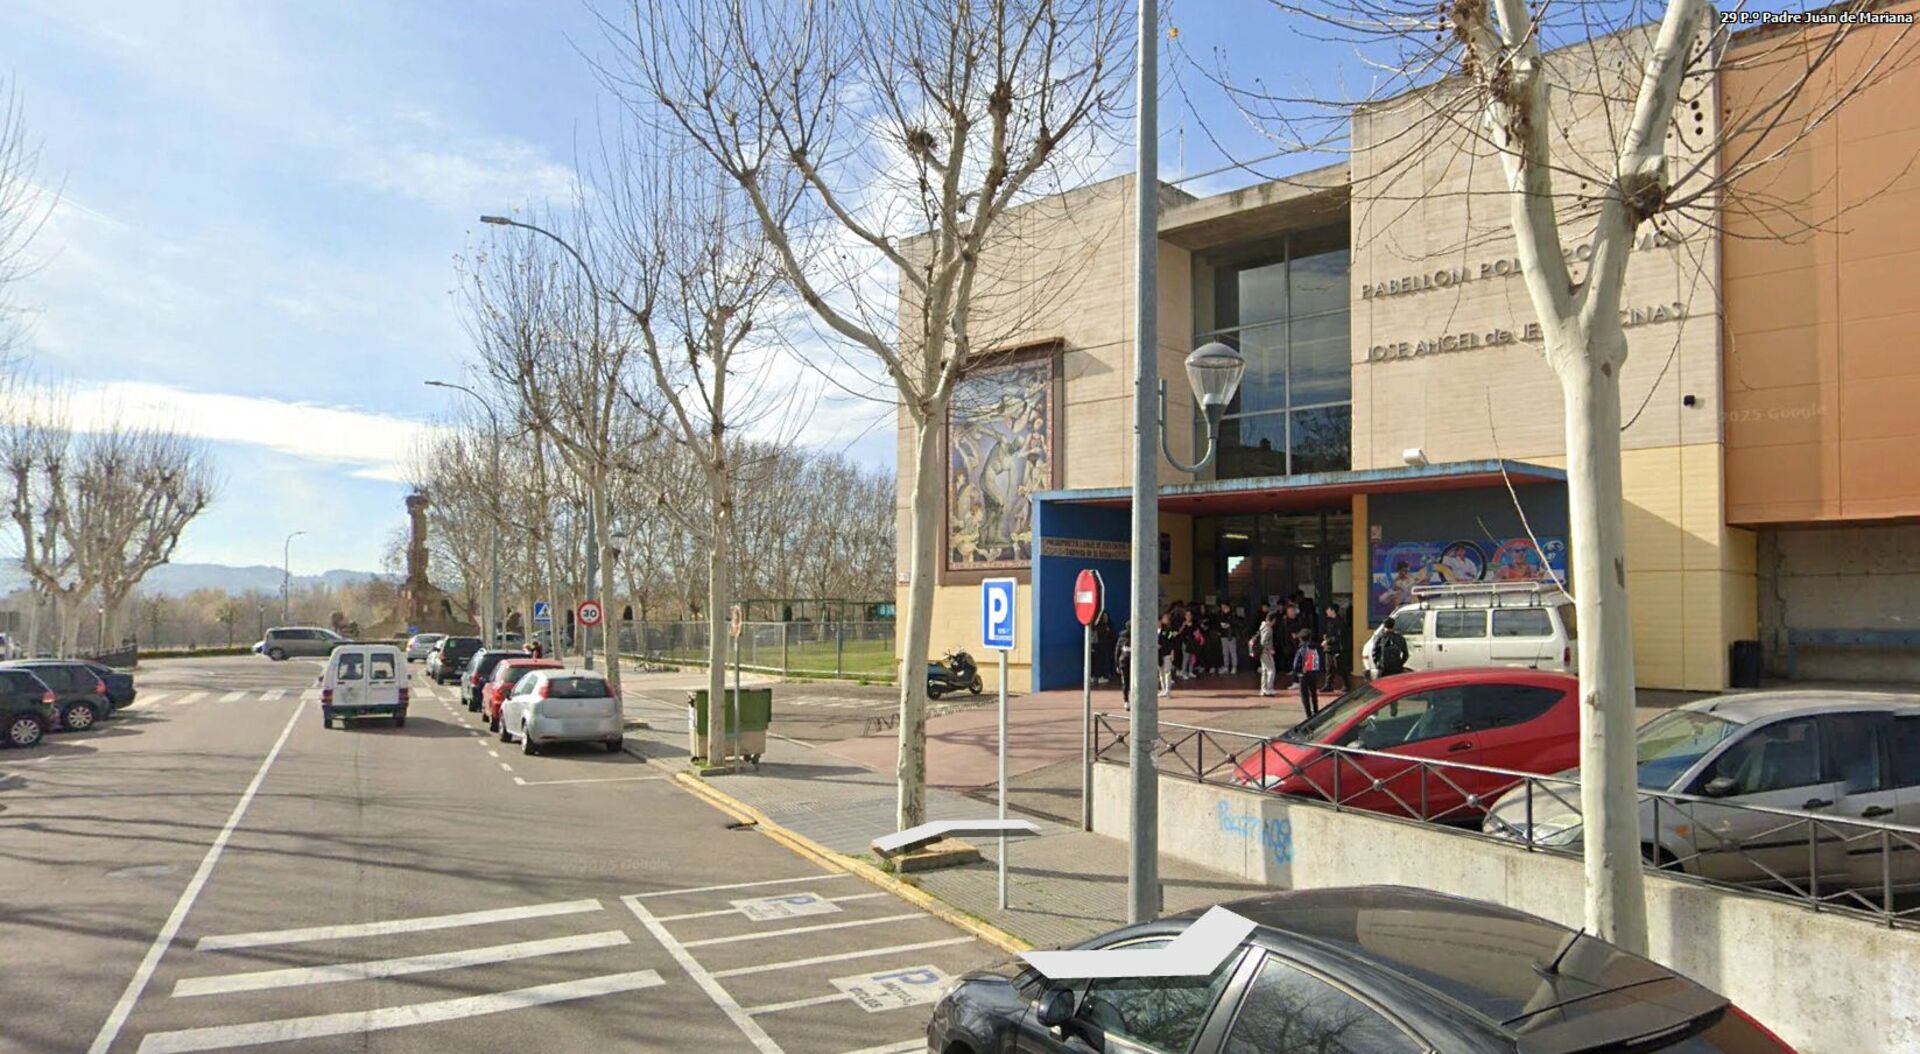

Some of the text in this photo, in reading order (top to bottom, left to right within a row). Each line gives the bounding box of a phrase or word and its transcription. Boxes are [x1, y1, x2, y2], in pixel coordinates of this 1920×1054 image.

[1361, 264, 1469, 299] PABELLON
[1367, 342, 1411, 363] JOSE
[1414, 332, 1478, 357] ANGEL
[1485, 328, 1513, 345] de
[583, 609, 598, 618] 30
[988, 587, 1008, 641] P
[870, 968, 940, 985] P
